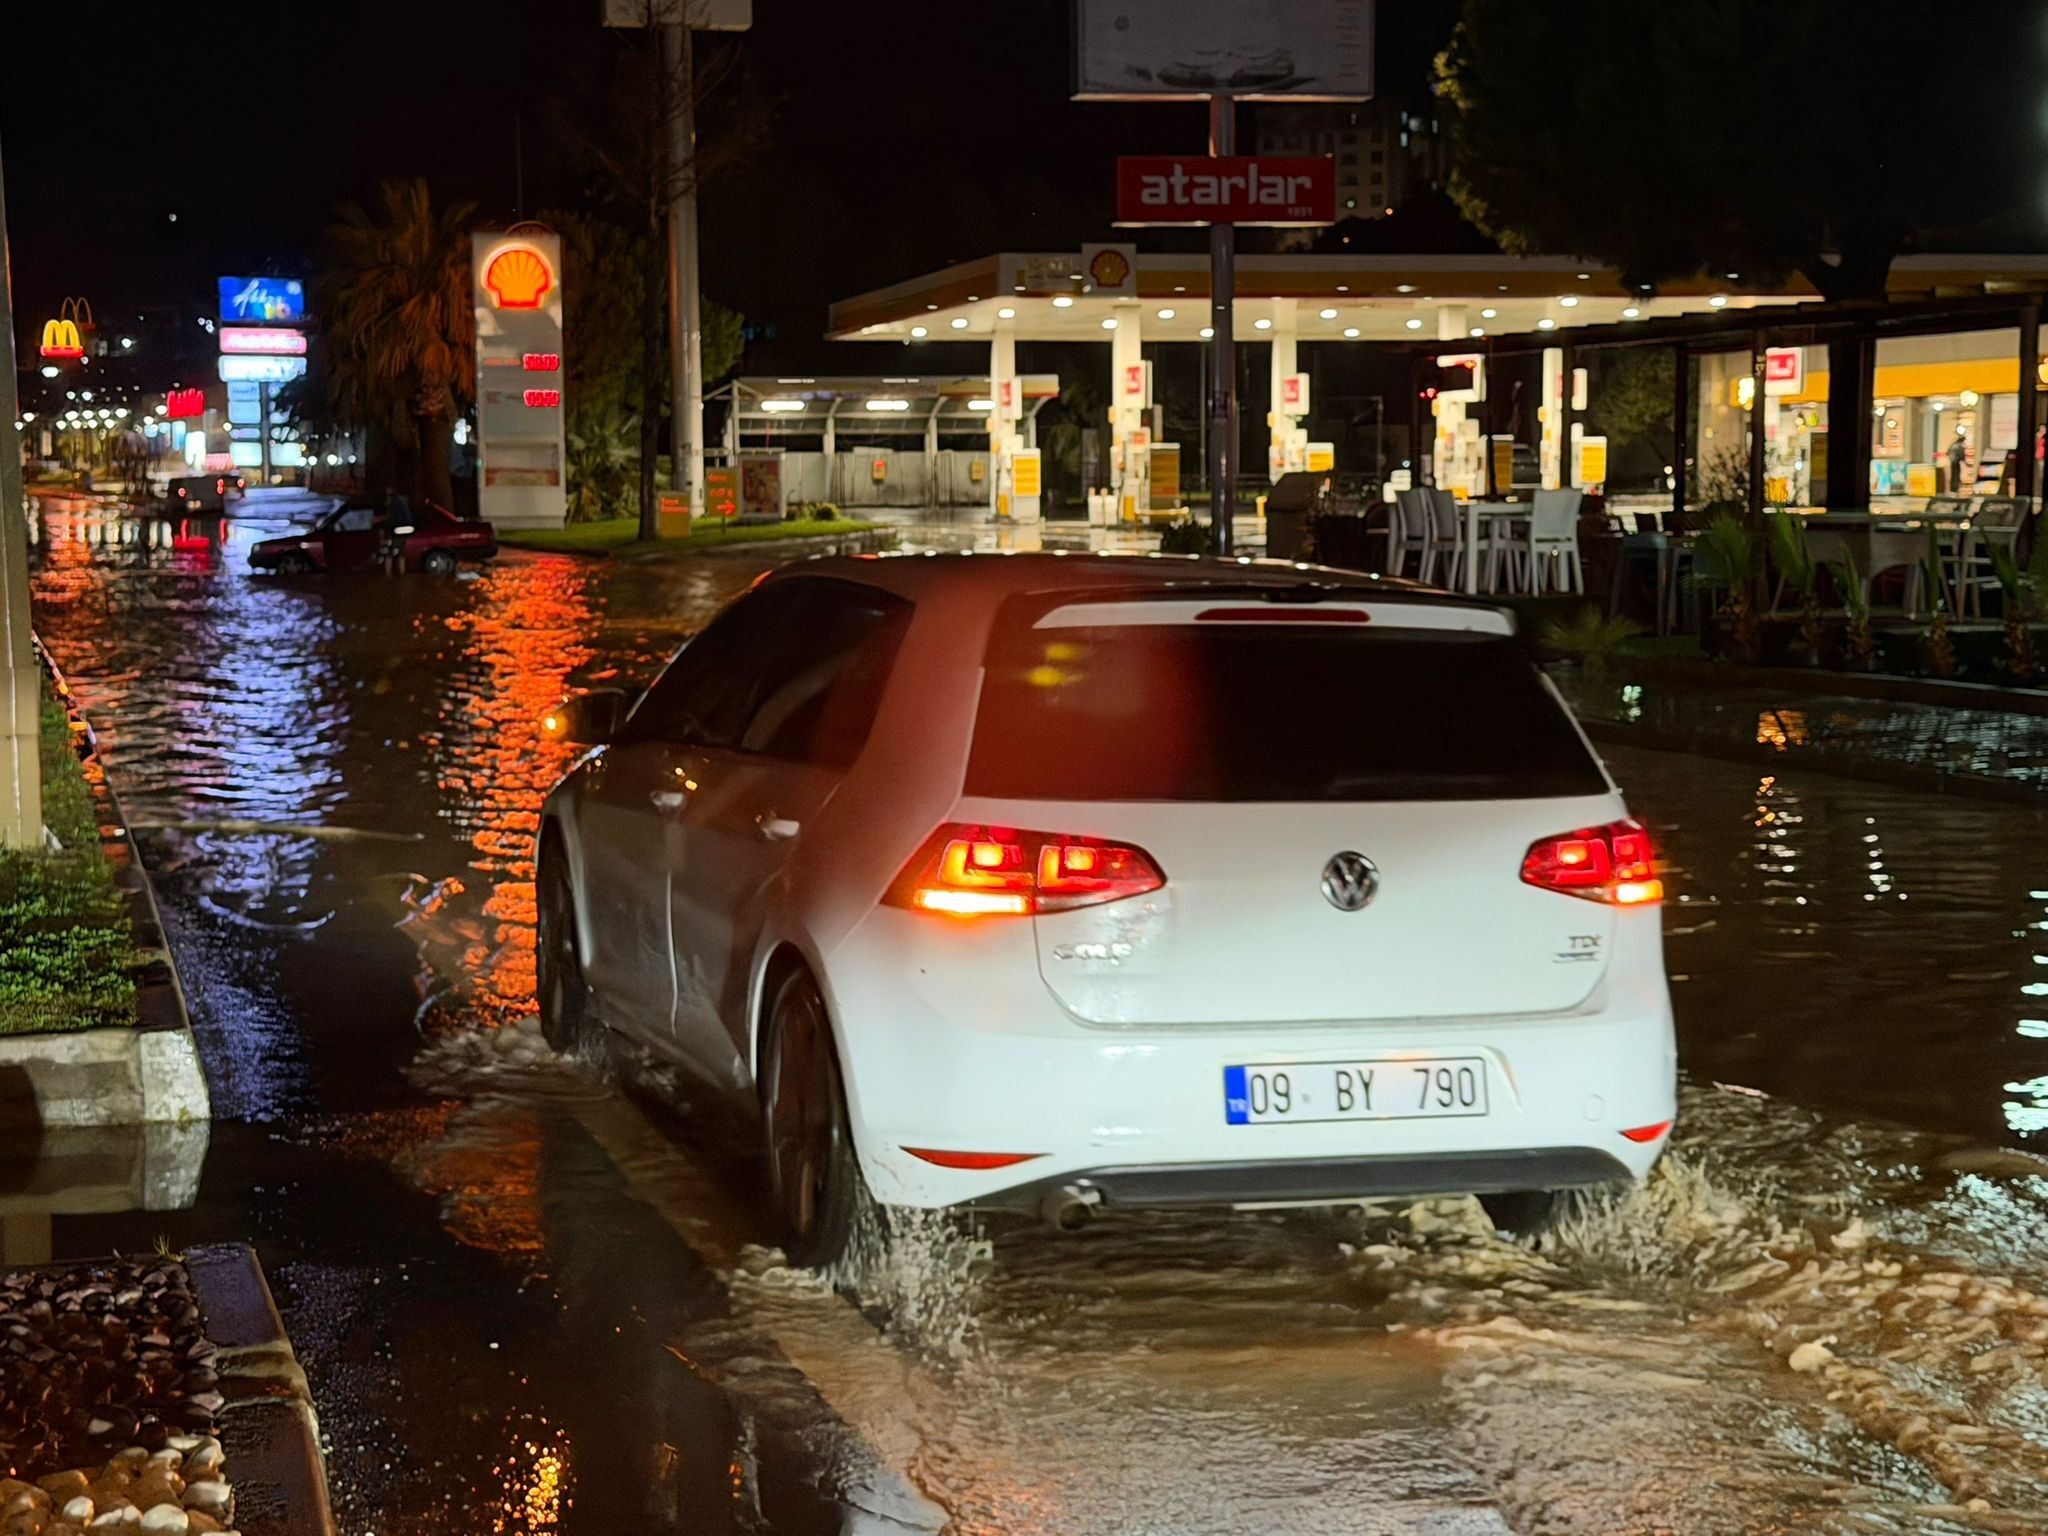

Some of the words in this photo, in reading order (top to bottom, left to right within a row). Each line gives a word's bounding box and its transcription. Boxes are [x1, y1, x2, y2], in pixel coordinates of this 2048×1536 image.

[1141, 163, 1313, 205] atarlar
[1250, 1072, 1291, 1115] 09
[1335, 1069, 1374, 1111] BY
[1413, 1067, 1476, 1110] 790
